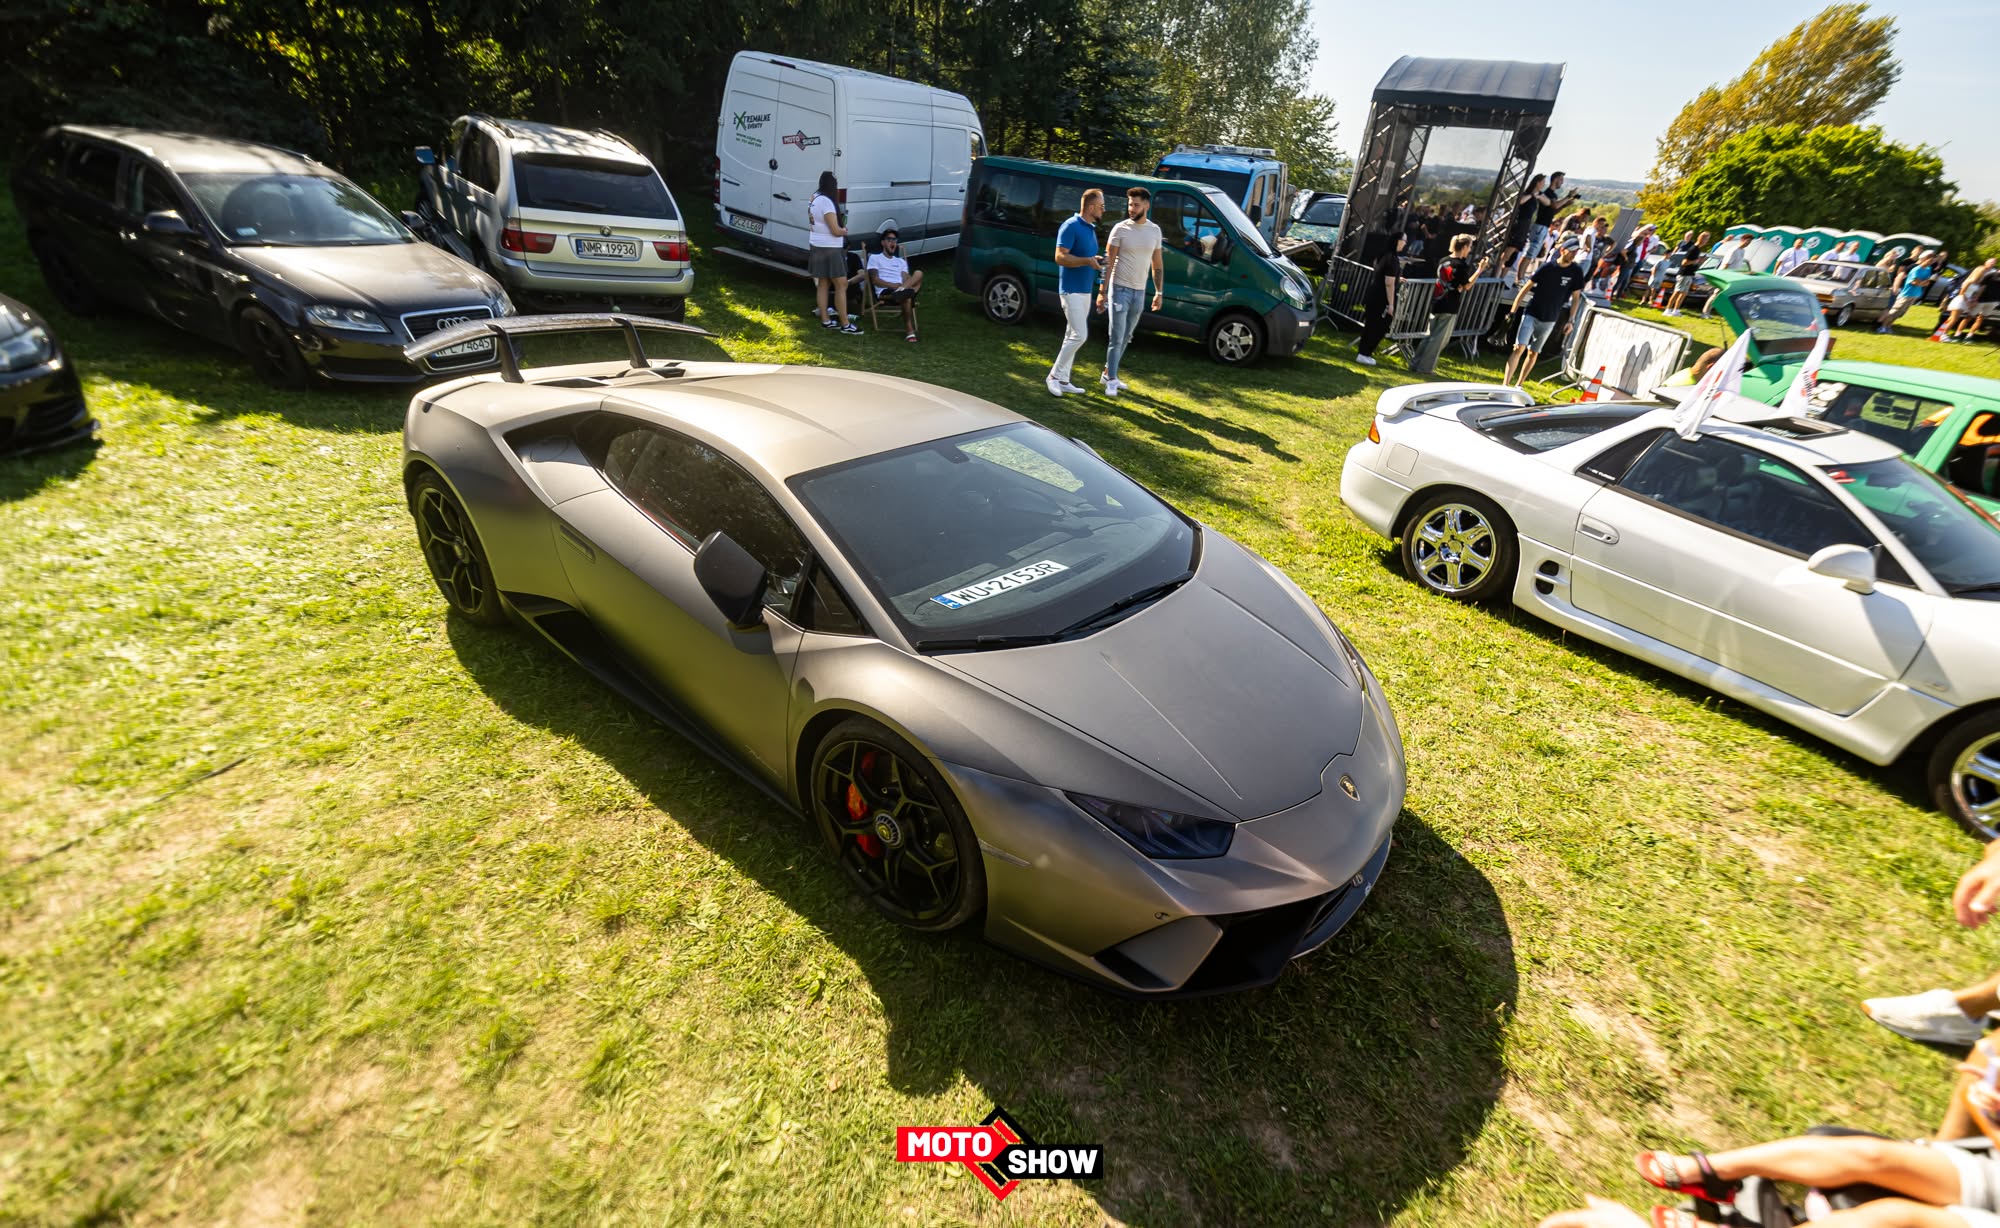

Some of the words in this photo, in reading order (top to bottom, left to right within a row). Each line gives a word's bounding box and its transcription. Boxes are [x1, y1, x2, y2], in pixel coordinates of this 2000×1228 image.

[783, 135, 800, 144] MOTO
[803, 137, 820, 145] SHOW
[583, 241, 602, 253] NMR
[606, 242, 634, 255] 19936
[951, 586, 991, 602] WU
[988, 562, 1060, 591] 2153R
